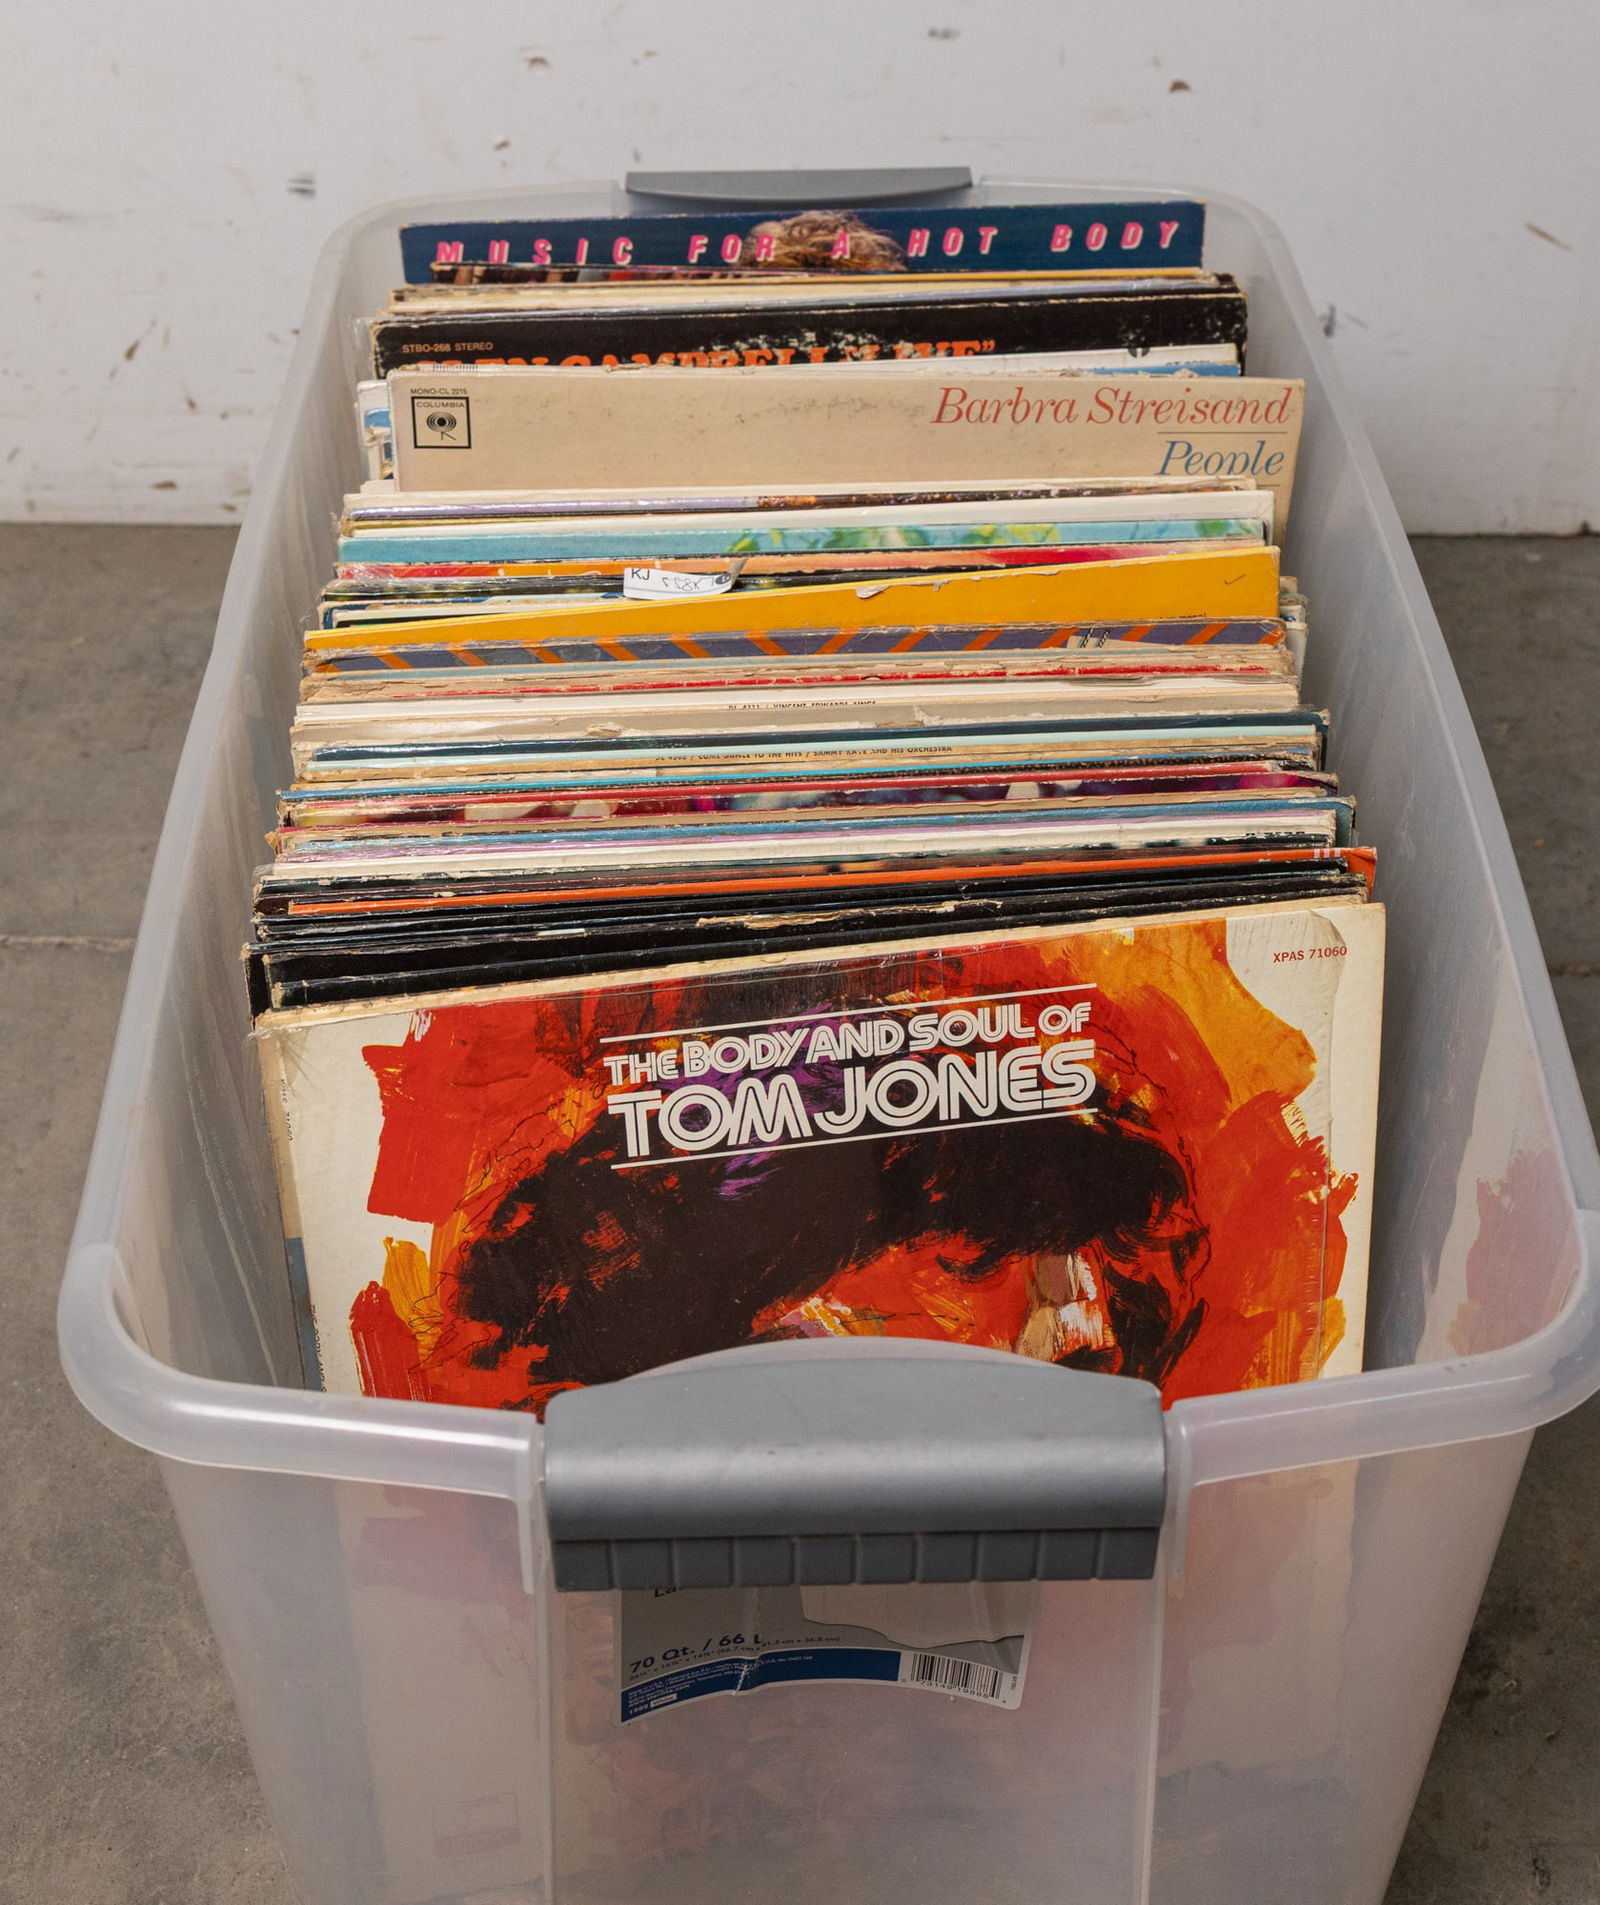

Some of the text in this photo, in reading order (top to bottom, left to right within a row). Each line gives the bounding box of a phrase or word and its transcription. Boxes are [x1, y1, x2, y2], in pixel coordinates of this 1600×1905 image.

[436, 220, 1180, 265] MUSIC FOR A HOT BODY
[402, 342, 494, 353] STBO-268 STEREO
[410, 387, 450, 395] MONO-CL
[930, 386, 1293, 425] Barbra Streisand
[1154, 440, 1285, 477] People
[1272, 945, 1348, 963] XPAS 71060
[602, 1001, 1093, 1086] THE BODY AND SOUL OF
[607, 1038, 1098, 1158] TOM JONES
[629, 1655, 656, 1674] 70
[661, 1645, 696, 1662] Qt.
[702, 1638, 713, 1652] /
[718, 1633, 746, 1646] 66
